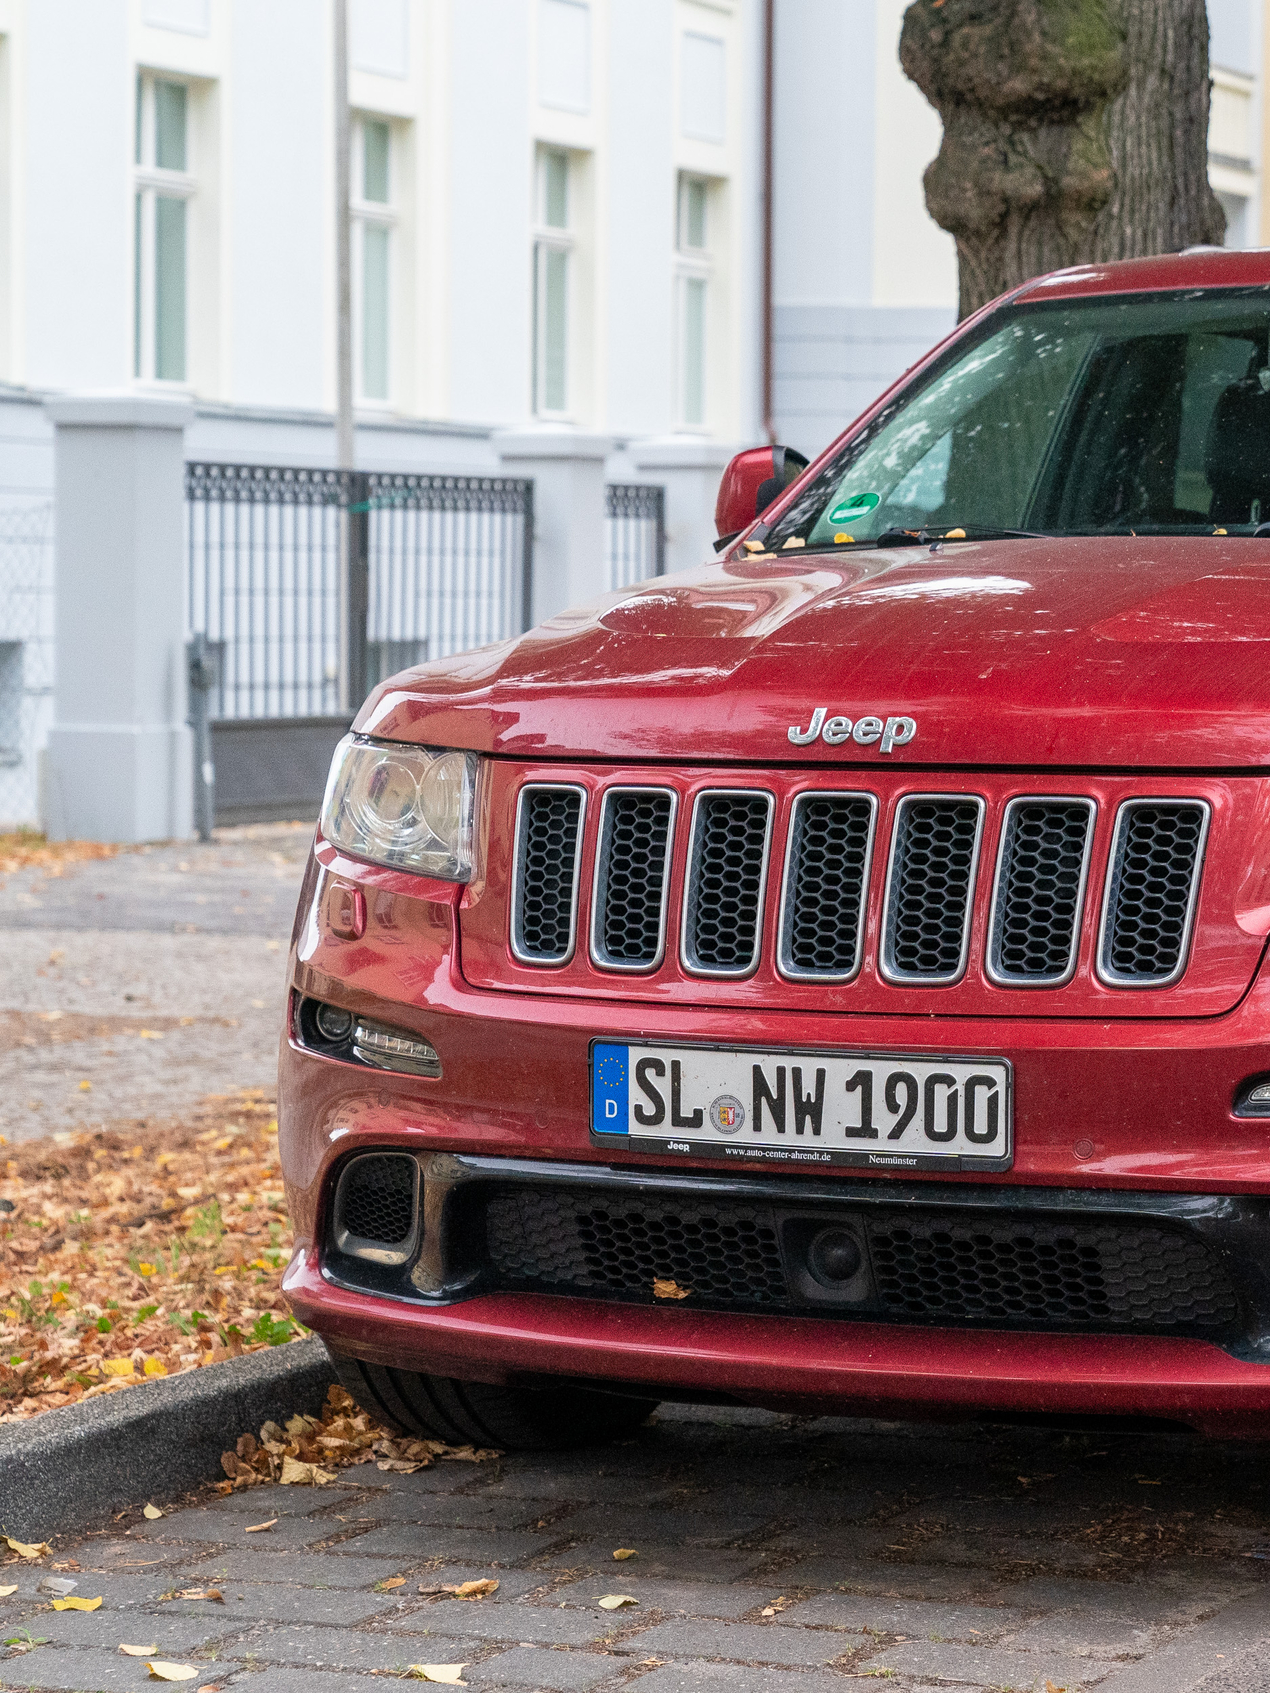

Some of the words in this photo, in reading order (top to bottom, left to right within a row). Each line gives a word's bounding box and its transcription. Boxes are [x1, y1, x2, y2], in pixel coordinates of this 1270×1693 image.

[787, 707, 917, 753] Jeep
[605, 1099, 618, 1118] D
[634, 1057, 704, 1129] SL
[752, 1064, 826, 1136] NW
[845, 1069, 1000, 1144] 1900
[667, 1141, 690, 1152] Jeep
[725, 1147, 832, 1161] www.auto-center-ahrendt.de
[868, 1154, 918, 1166] Neumünster
